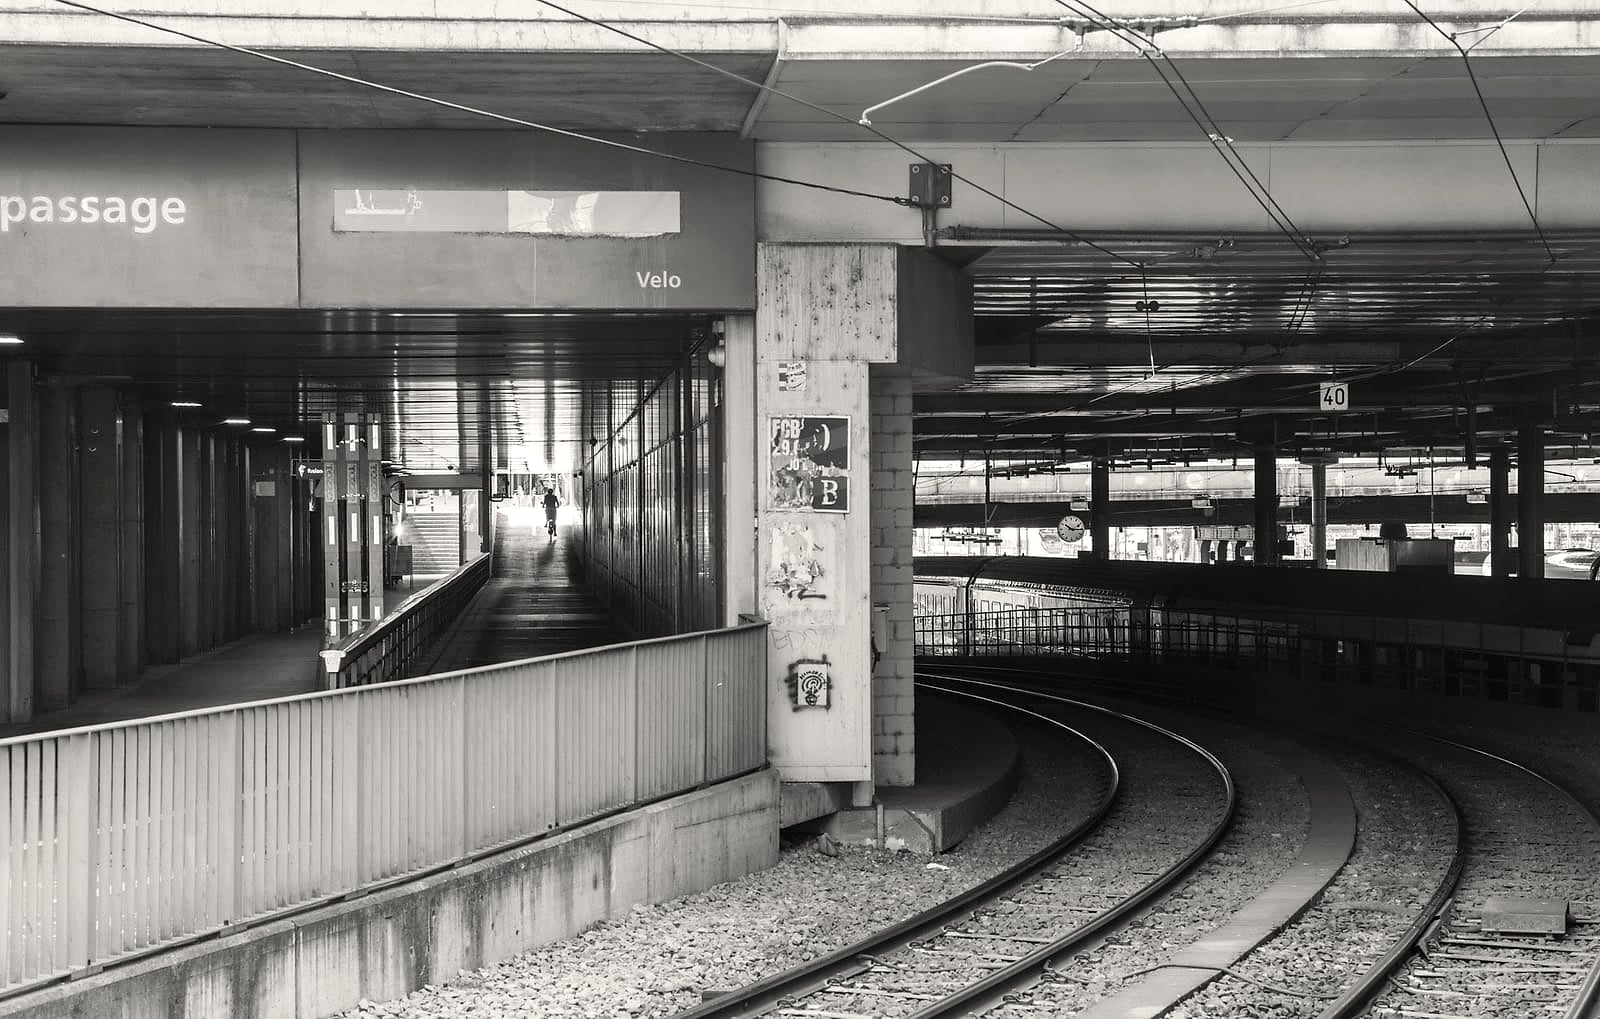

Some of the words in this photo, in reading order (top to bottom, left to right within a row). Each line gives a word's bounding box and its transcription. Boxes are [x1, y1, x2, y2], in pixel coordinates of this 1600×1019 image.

[0, 196, 186, 233] passage
[636, 270, 681, 288] Velo
[1323, 388, 1345, 405] 40
